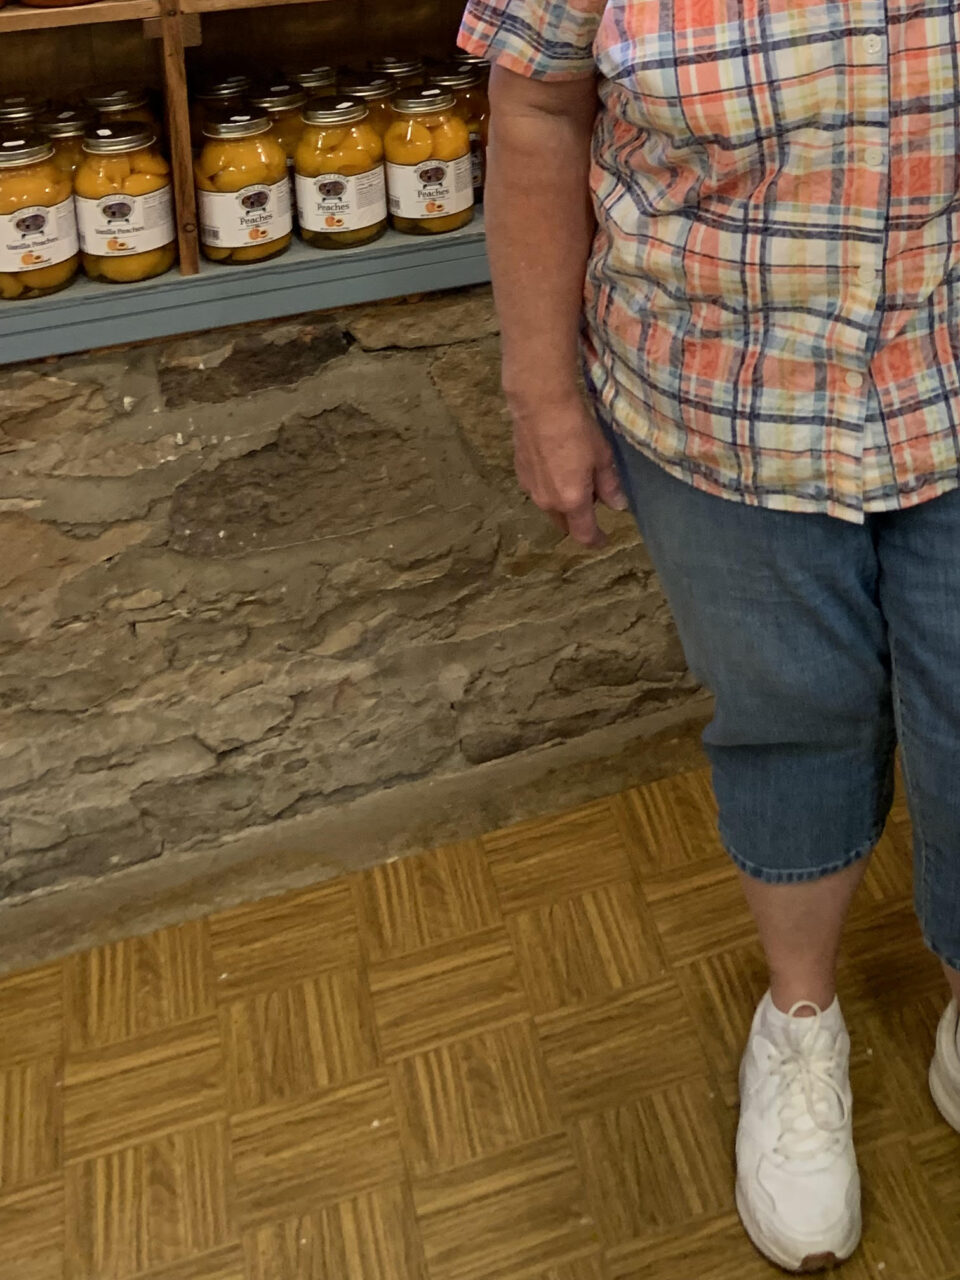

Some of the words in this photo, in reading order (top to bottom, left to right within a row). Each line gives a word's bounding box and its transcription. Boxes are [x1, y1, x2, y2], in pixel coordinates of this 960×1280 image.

[417, 189, 450, 198] Peaches
[317, 203, 350, 211] Peaches
[240, 213, 273, 225] Peaches
